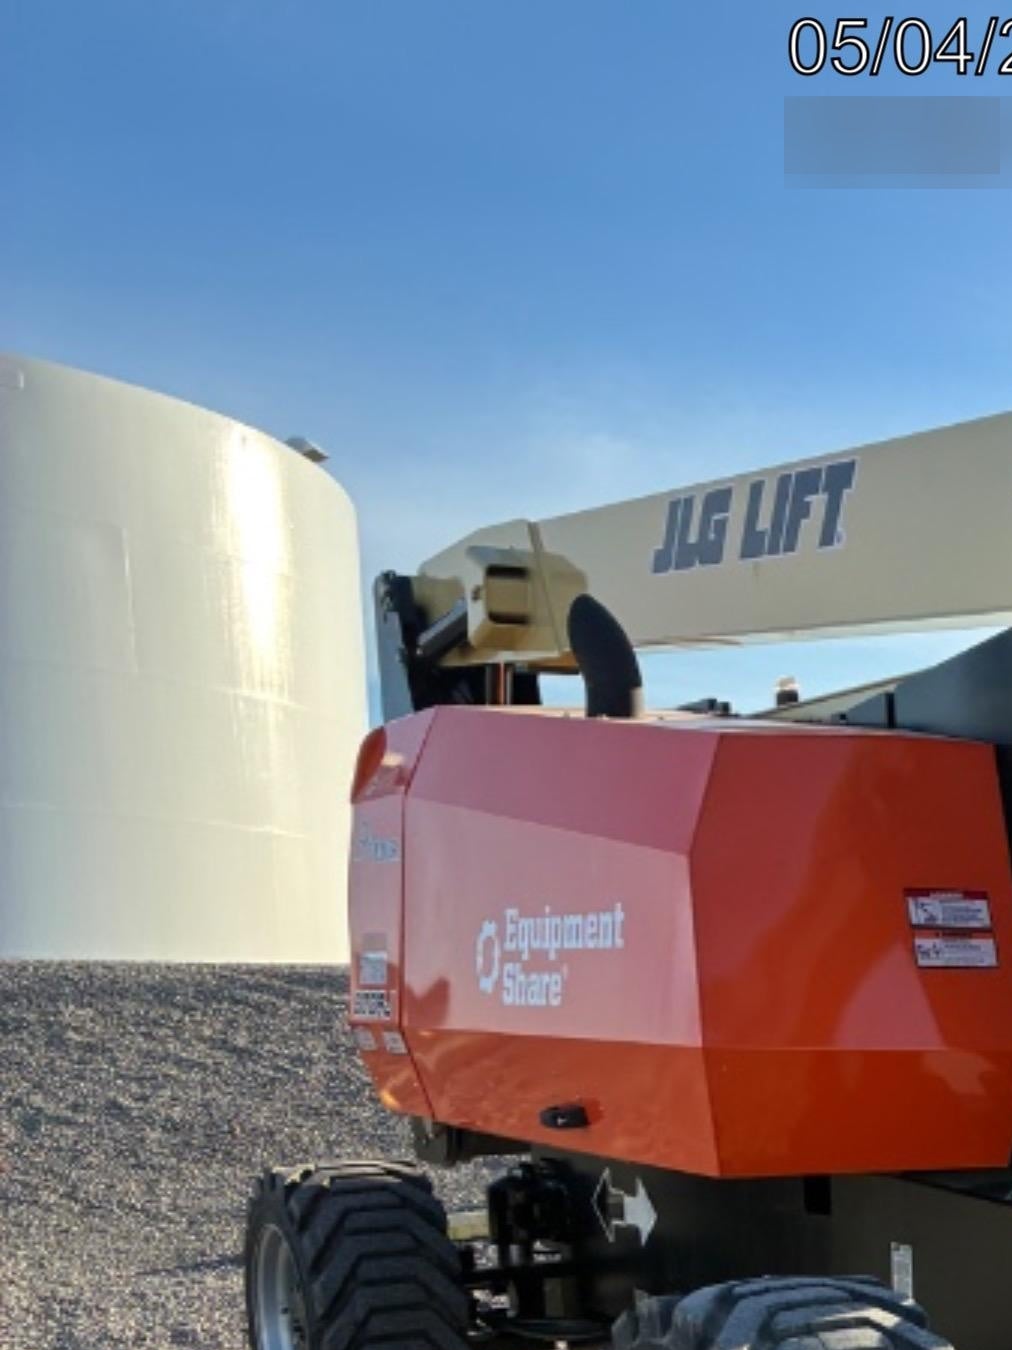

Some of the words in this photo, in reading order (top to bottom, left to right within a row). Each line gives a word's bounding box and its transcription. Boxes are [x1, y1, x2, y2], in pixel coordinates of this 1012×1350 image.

[651, 485, 734, 574] JLG
[739, 458, 857, 561] LIFT
[504, 901, 625, 960] Equipment
[502, 961, 562, 1007] Share
